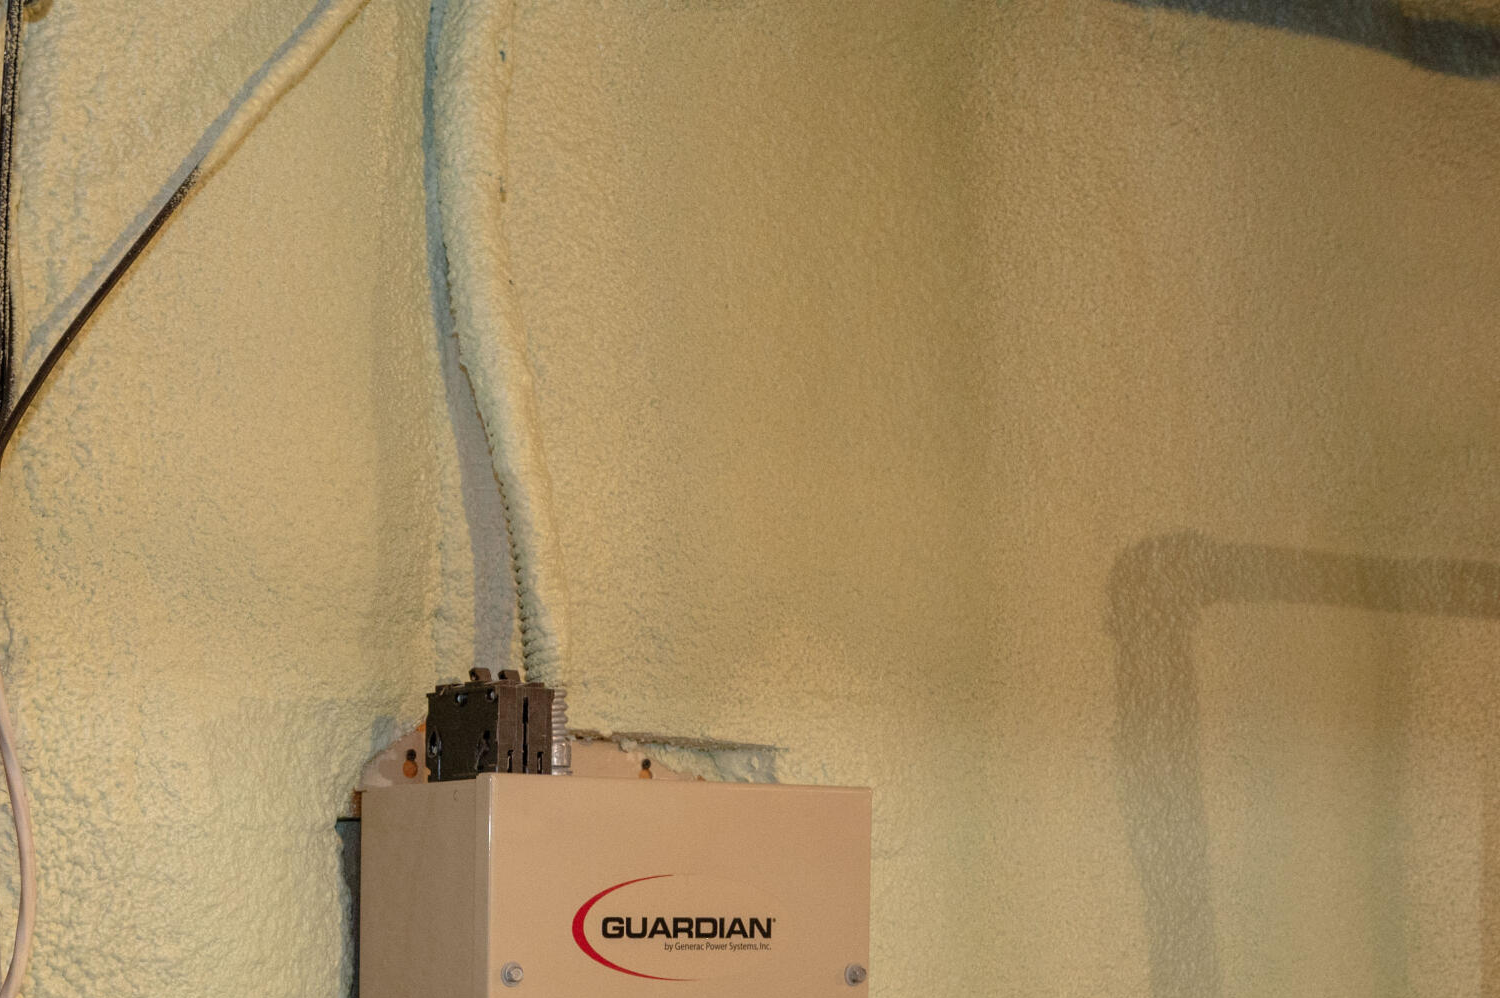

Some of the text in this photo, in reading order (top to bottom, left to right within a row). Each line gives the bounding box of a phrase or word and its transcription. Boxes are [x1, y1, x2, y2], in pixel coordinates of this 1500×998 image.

[601, 917, 772, 939] GUARDIAN
[664, 942, 772, 952] by Generac Power Systems, Inc.
